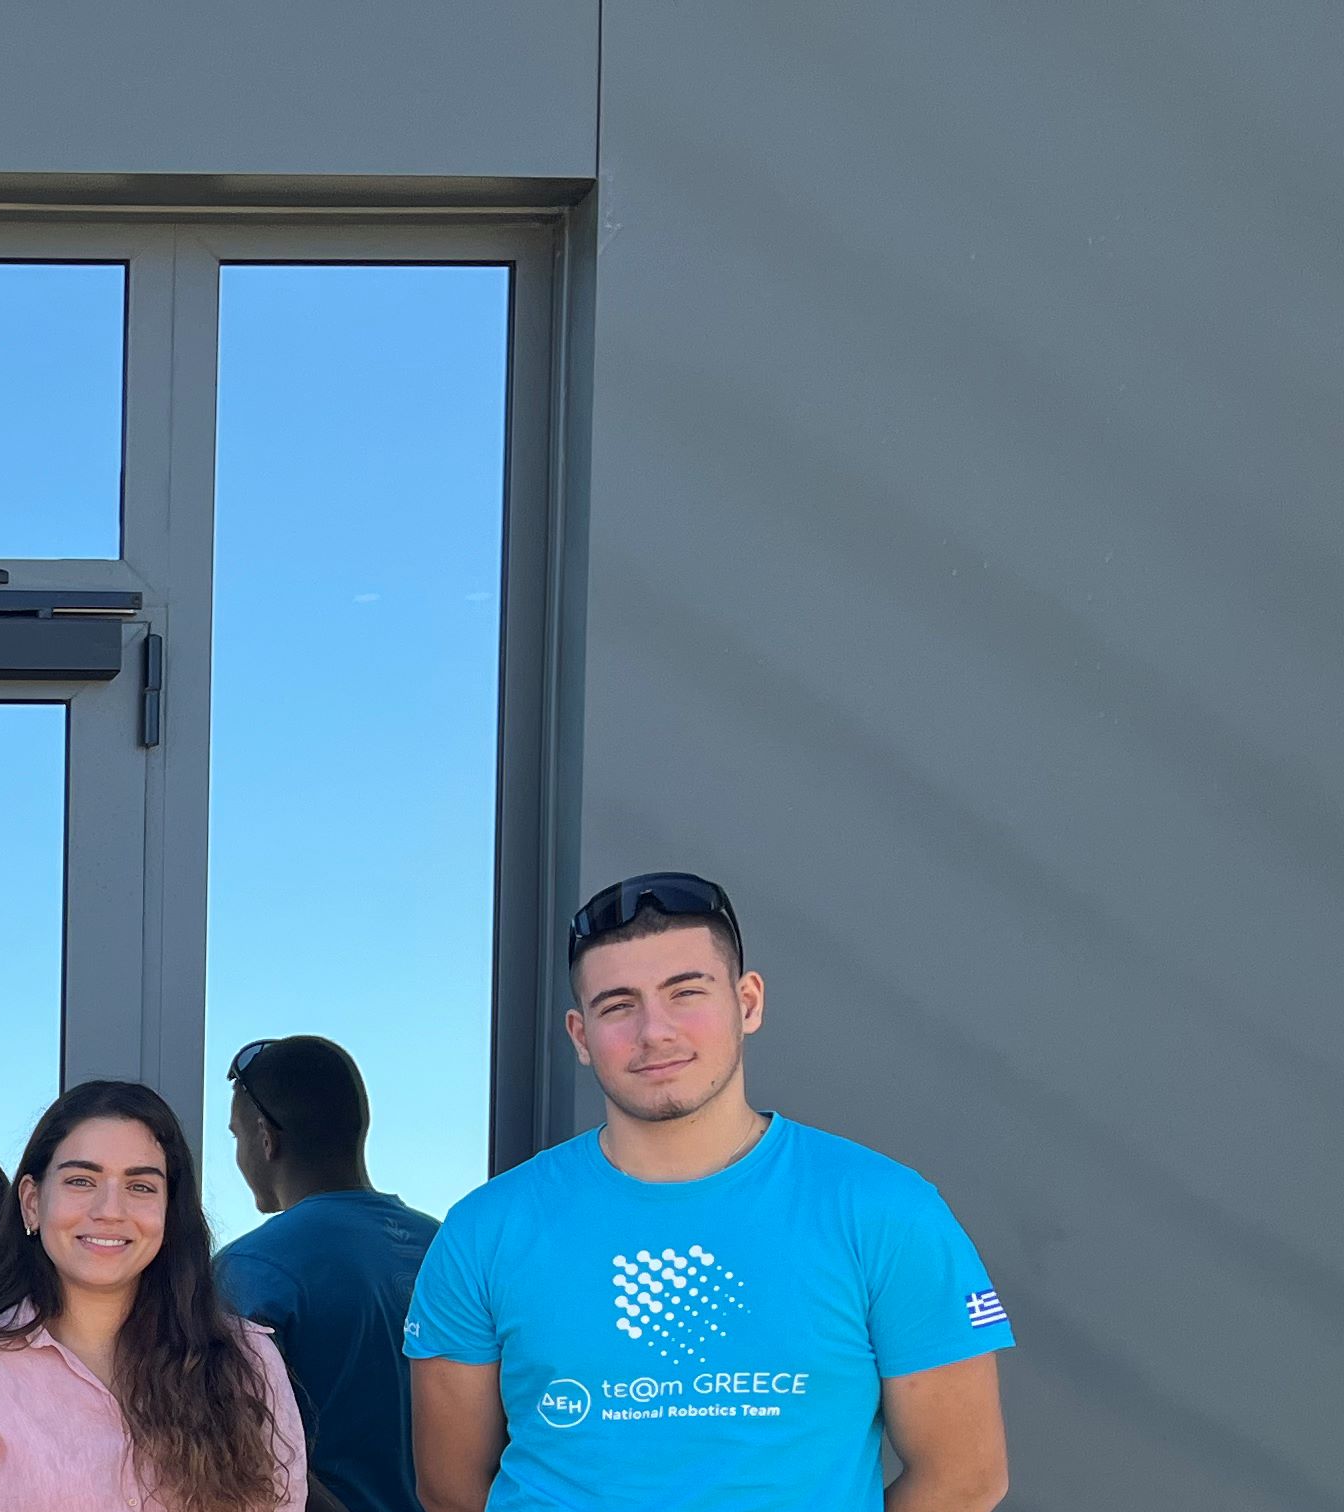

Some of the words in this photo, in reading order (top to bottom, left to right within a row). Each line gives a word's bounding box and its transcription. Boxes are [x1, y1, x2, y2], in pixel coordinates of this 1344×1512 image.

[694, 1372, 808, 1394] GREECE
[602, 1406, 663, 1420] National
[668, 1404, 736, 1417] Robotics
[741, 1405, 780, 1416] Team
